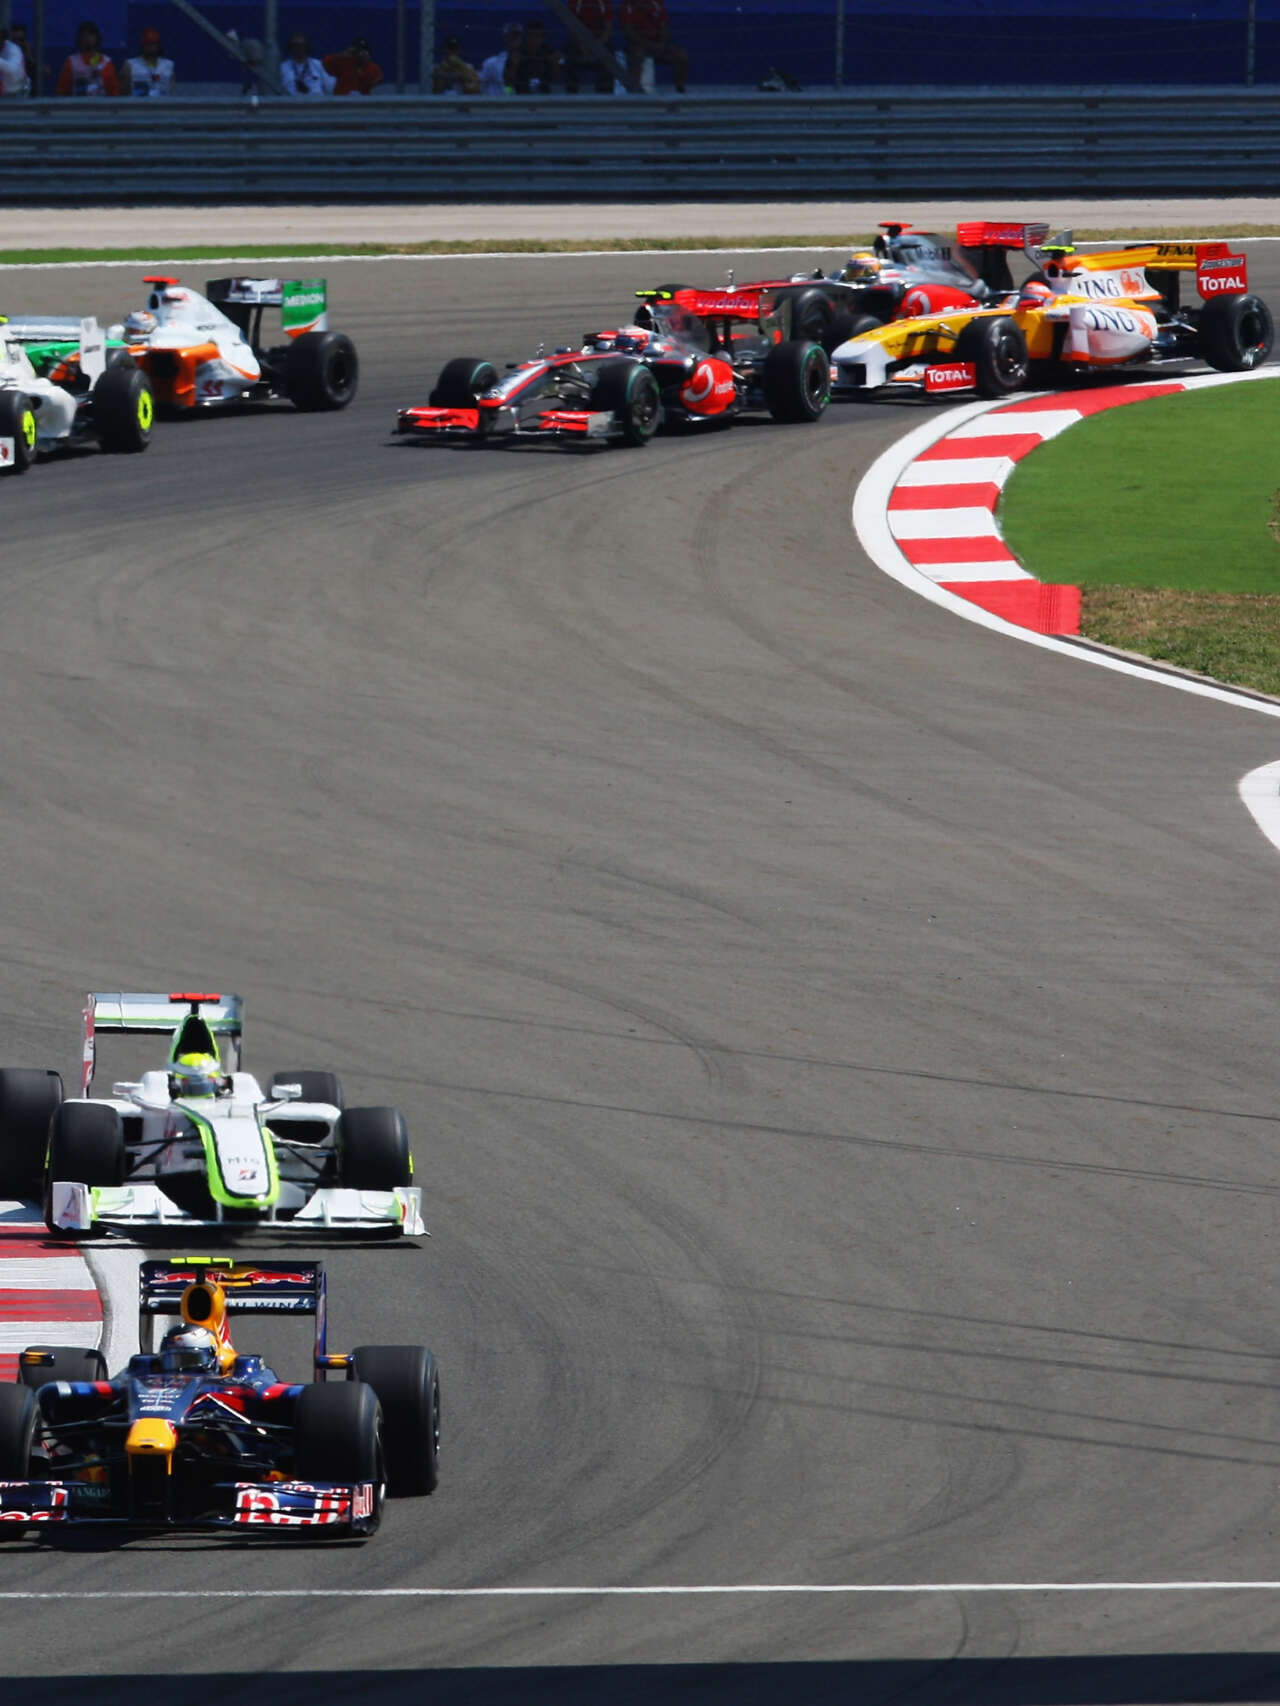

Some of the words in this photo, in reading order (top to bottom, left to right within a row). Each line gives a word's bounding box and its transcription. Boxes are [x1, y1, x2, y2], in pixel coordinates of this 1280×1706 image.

[1083, 278, 1120, 298] ING
[1200, 276, 1246, 291] TOTAL
[1087, 309, 1135, 332] ING
[927, 370, 972, 384] TOTAL
